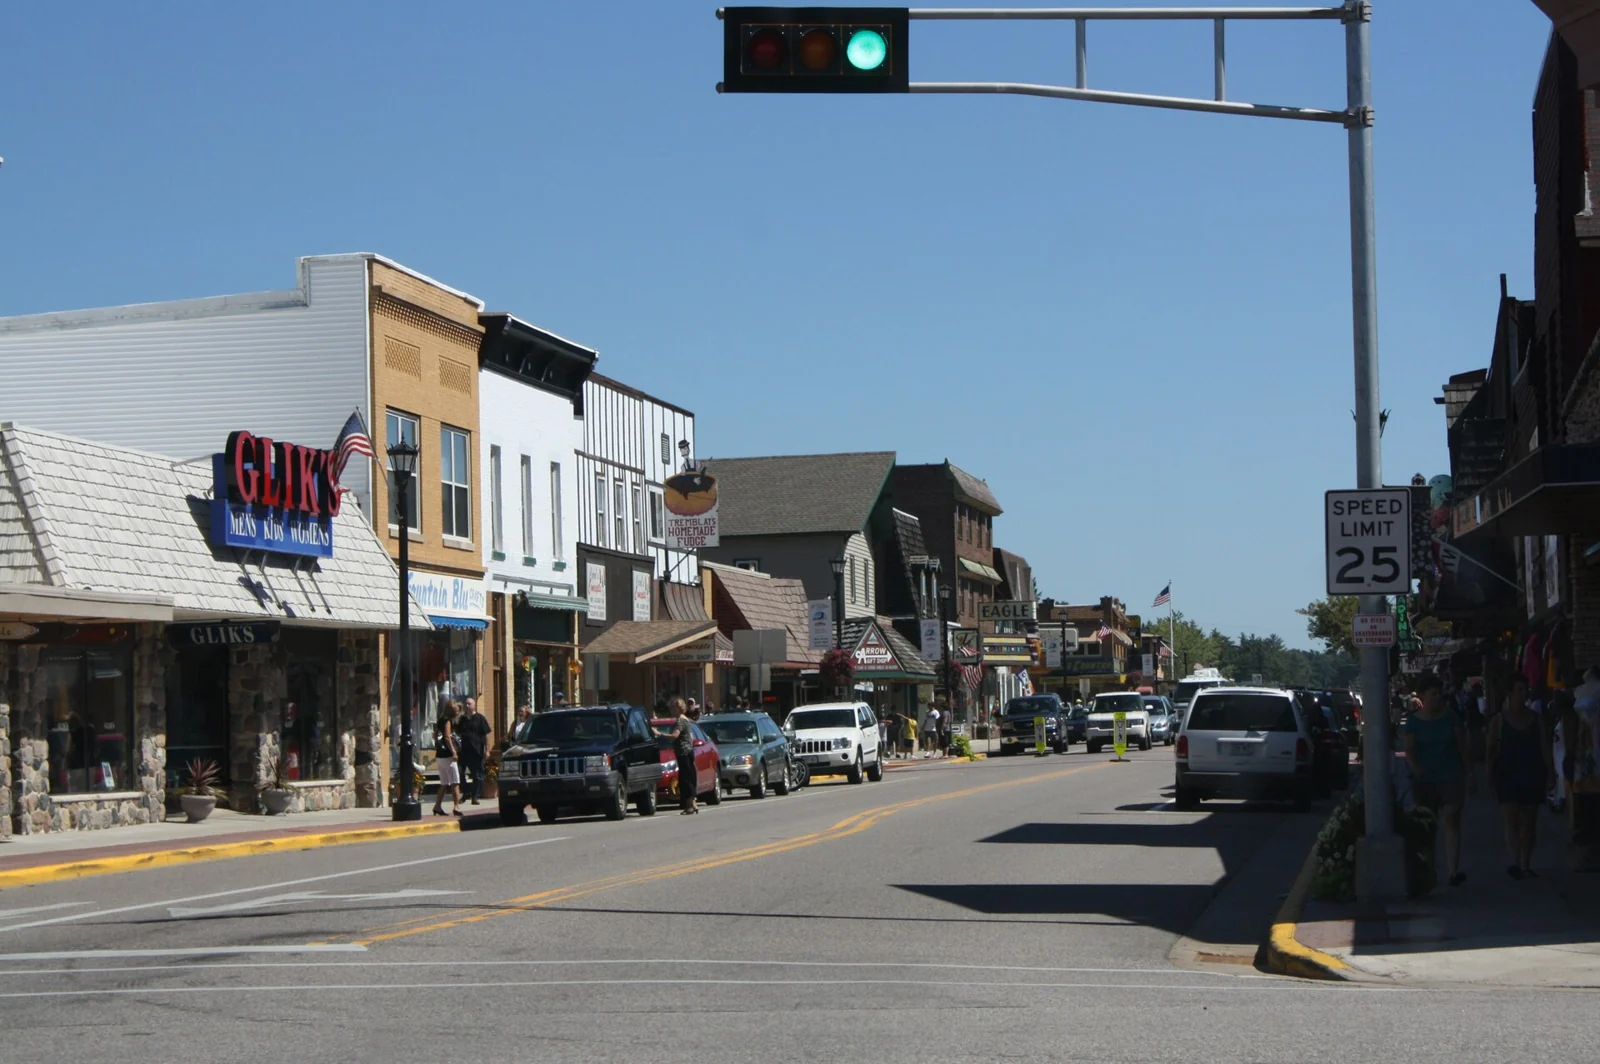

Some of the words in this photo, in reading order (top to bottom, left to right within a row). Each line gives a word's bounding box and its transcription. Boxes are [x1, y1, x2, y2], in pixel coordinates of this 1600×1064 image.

[234, 430, 341, 517] GLIK'S
[1333, 499, 1402, 516] SPEED
[229, 511, 257, 538] MENS
[290, 520, 330, 547] WOMENS
[668, 526, 716, 537] HOMEMADE
[1341, 520, 1394, 537] LIMIT
[677, 536, 707, 547] FUDGE
[1335, 546, 1401, 584] 25
[408, 571, 448, 608] ountain
[452, 578, 469, 611] Blu
[982, 604, 1029, 618] EAGLE
[190, 624, 256, 645] GLIK'S
[856, 648, 888, 664] ARROW
